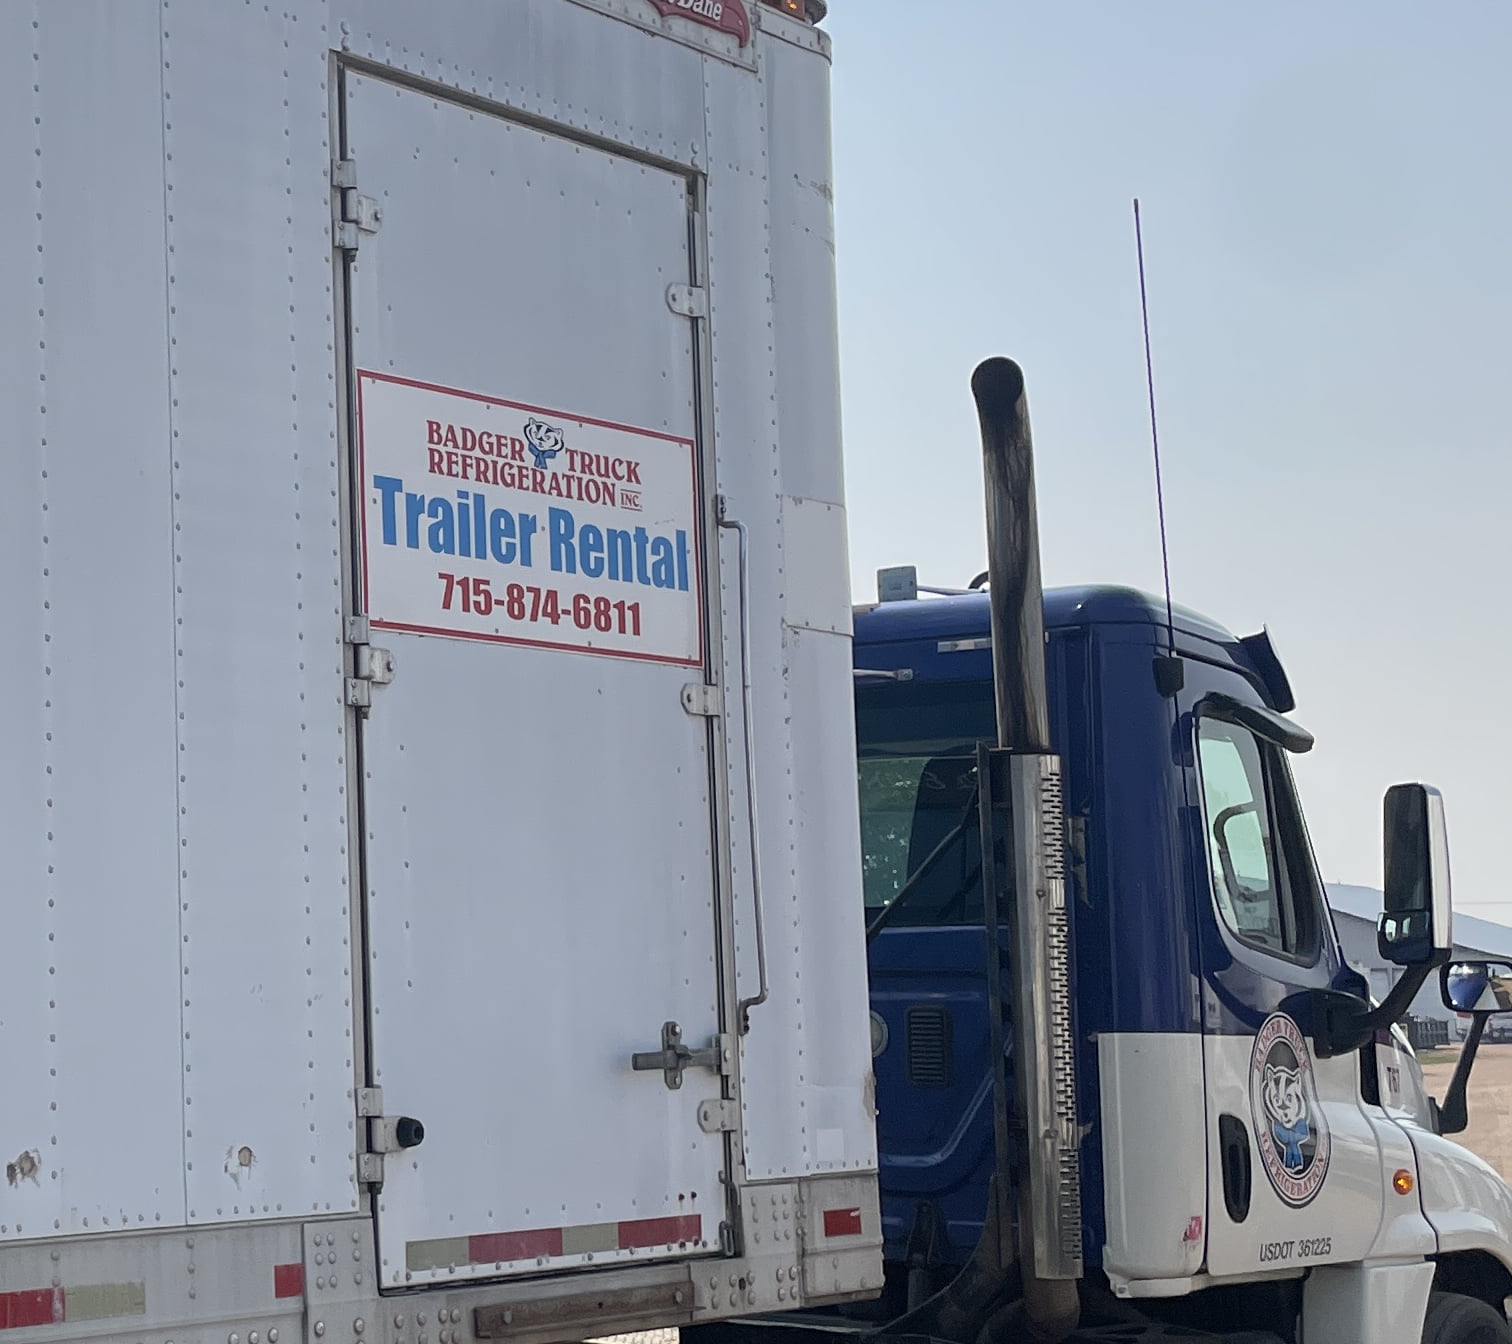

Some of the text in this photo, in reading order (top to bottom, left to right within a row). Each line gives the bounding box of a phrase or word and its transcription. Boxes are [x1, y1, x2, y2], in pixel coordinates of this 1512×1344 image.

[426, 419, 642, 485] BADGER TRUCK
[427, 447, 617, 507] REFRIGERATION
[373, 474, 689, 592] Trailer Rental
[438, 572, 641, 636] 715-874-6811
[1260, 1236, 1331, 1262] USDOT 361225
